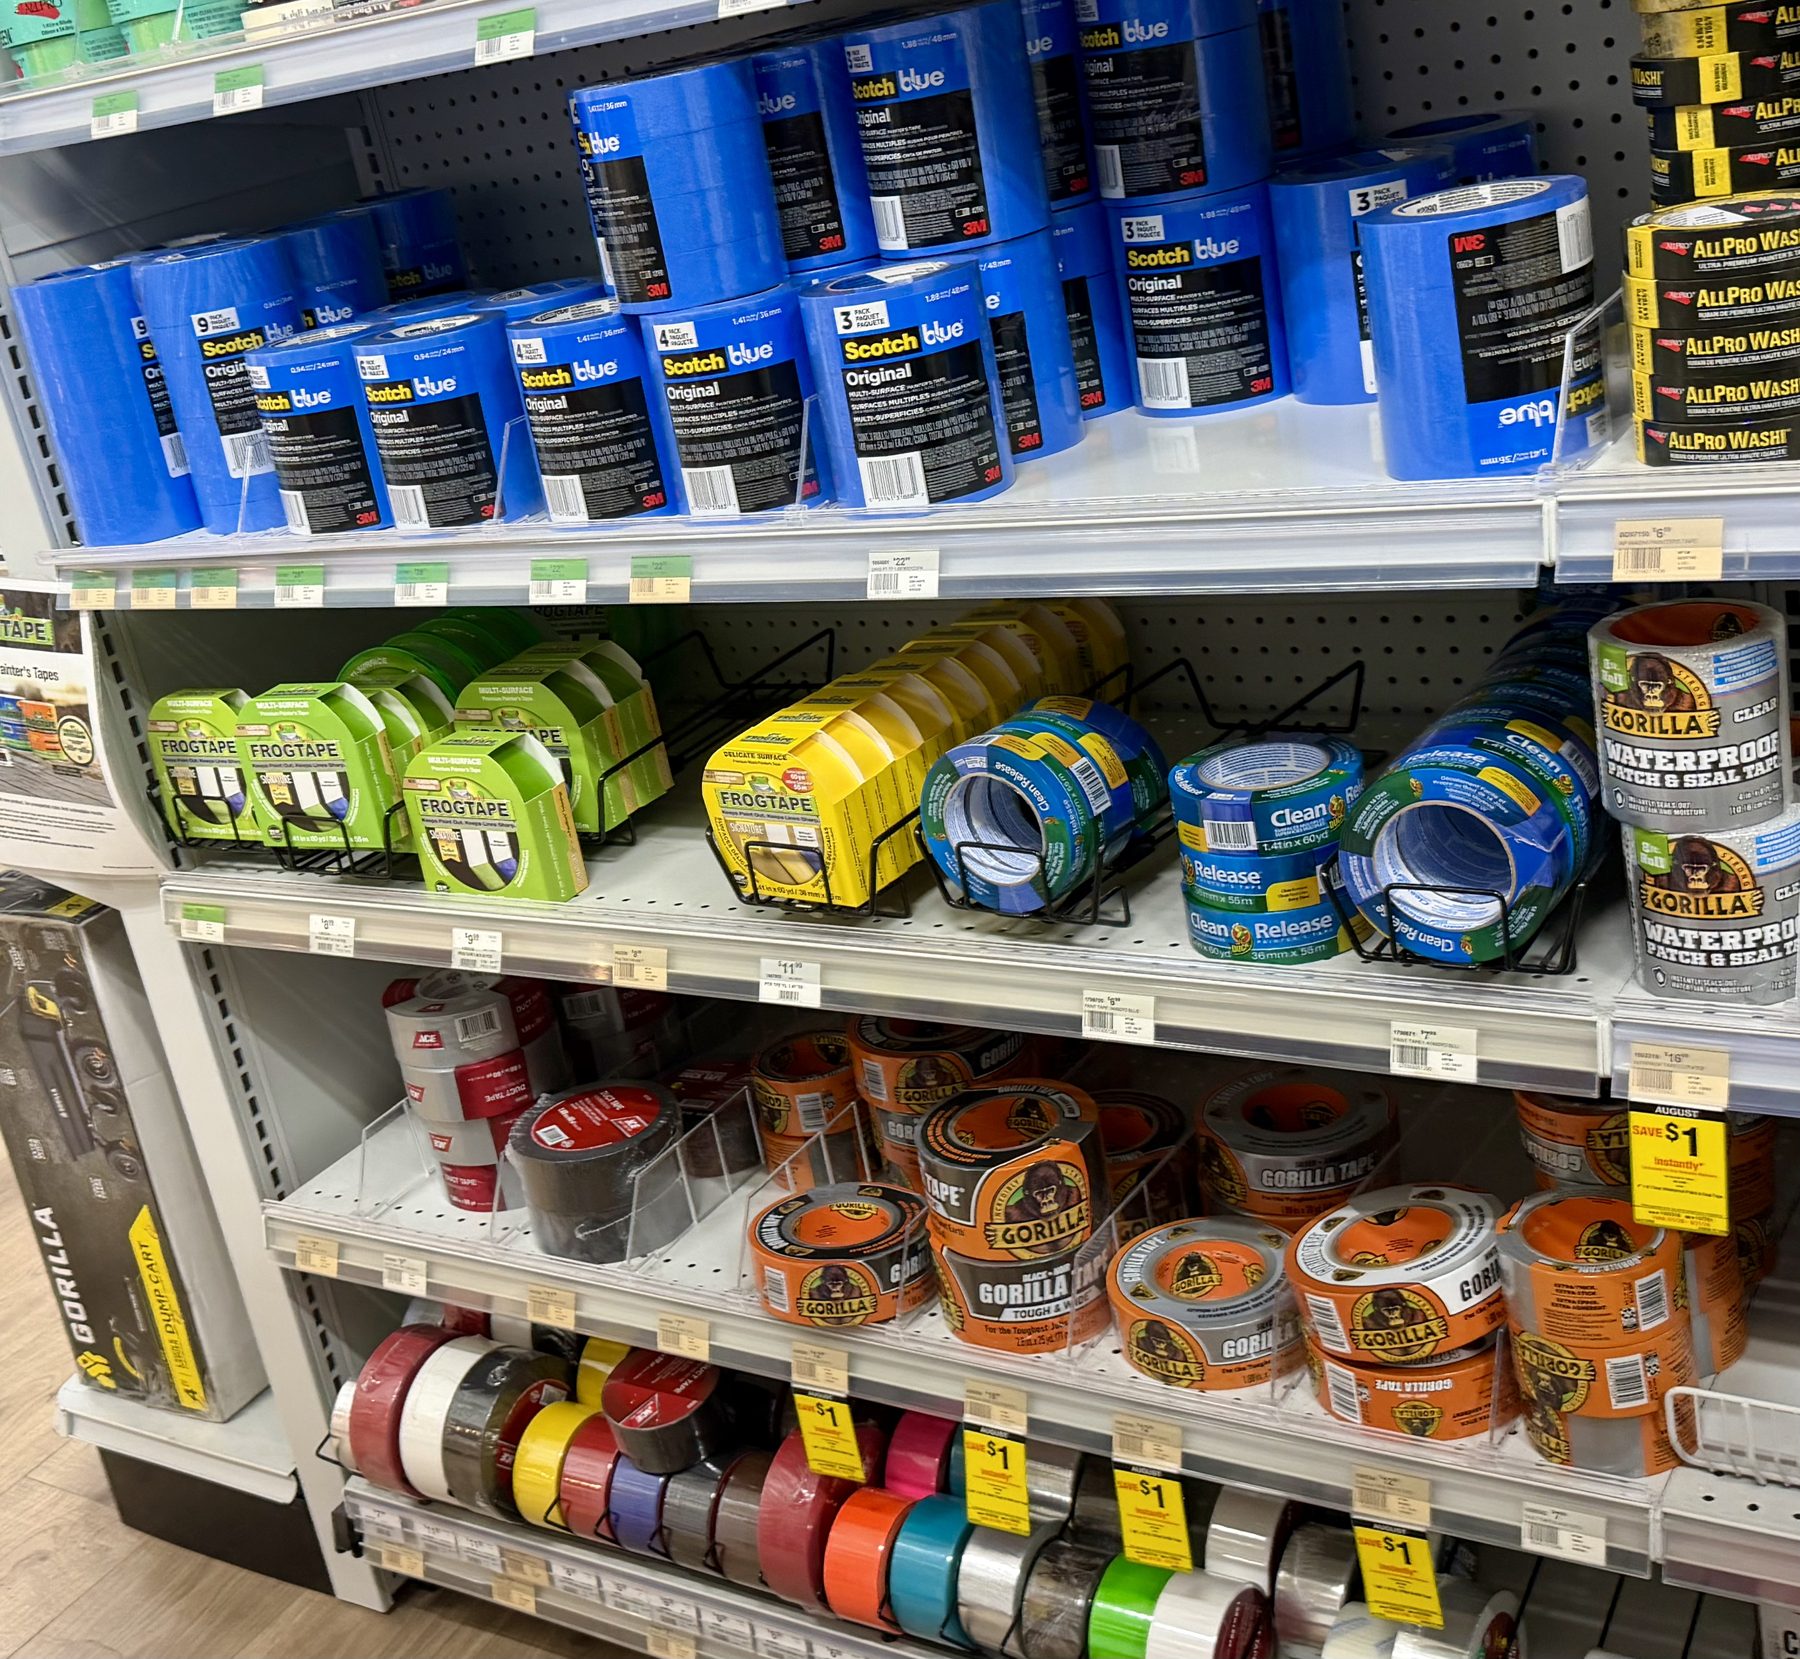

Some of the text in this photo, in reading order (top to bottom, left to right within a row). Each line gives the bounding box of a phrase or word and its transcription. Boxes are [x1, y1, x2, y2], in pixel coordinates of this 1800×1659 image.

[1122, 19, 1168, 42] blue
[898, 68, 945, 91] blue
[1180, 169, 1204, 185] 3M
[1374, 187, 1391, 195] PACK
[1356, 192, 1370, 211] 3
[963, 219, 987, 236] 3M
[1124, 222, 1135, 239] 3
[819, 235, 842, 249] 3M
[1454, 234, 1486, 253] 3M
[1127, 237, 1239, 267] Scotch blue
[1698, 258, 1757, 270] ULTRA PREMIUM
[646, 283, 668, 297] 3M
[1128, 275, 1182, 293] Original
[315, 305, 352, 324] blue
[854, 308, 871, 316] PACK
[856, 313, 880, 321] PAQUET
[1160, 304, 1198, 313] MULTIPLES
[197, 317, 209, 333] 9
[840, 310, 853, 330] 3
[856, 318, 885, 327] PAQUETE
[202, 322, 293, 356] Scotch blue
[658, 329, 669, 347] 4
[845, 321, 964, 360] Scotch blue
[1749, 328, 1800, 351] WASH
[516, 344, 523, 360] 4
[663, 342, 773, 378] Scotch blue
[522, 359, 618, 389] Scotch blue
[846, 363, 913, 387] Original
[366, 375, 456, 403] Scotch blue
[667, 382, 720, 402] Original
[848, 385, 906, 398] MULTI-SURFACE
[1250, 378, 1270, 392] 3M
[291, 389, 331, 407] blue
[525, 396, 568, 414] Original
[851, 393, 931, 410] SURFACES MULTIPLES
[1081, 392, 1102, 406] 3M
[370, 410, 409, 426] Original
[854, 408, 925, 423] MULTI-SUPERFICIES
[1498, 399, 1556, 428] blue
[1018, 433, 1040, 449] 3M
[1728, 430, 1787, 448] WASHI
[984, 465, 1001, 483] 3M
[642, 492, 664, 508] 3M
[356, 511, 376, 524] 3M
[0, 663, 59, 682] ainter's Tapes
[1676, 670, 1706, 707] STRONG
[1734, 697, 1777, 723] CLEAR
[1611, 710, 1704, 734] GORILLA
[161, 740, 236, 754] FROGTAPE
[249, 743, 339, 759] FROGTAPE
[723, 751, 788, 761] DELICATE SURFACE
[1505, 733, 1562, 774] Clean
[1605, 731, 1779, 771] WATERPROOF
[1608, 761, 1741, 788] PATCH & SEAL
[995, 761, 1049, 812] Clean Release
[420, 799, 509, 816] FROGTAPE
[720, 792, 812, 811] FROGTAPE
[1271, 802, 1327, 826] Clean
[1303, 832, 1329, 845] 60yd
[1194, 862, 1261, 884] Release
[1721, 852, 1750, 887] STRONG
[1651, 892, 1748, 915] GORILLA
[1191, 912, 1229, 937] Clean
[1254, 916, 1332, 939] Release
[1417, 932, 1455, 952] Clean
[1251, 947, 1287, 960] 36mm
[1647, 941, 1783, 967] PATCH & SEAL
[417, 1034, 437, 1043] ACE
[485, 1084, 526, 1103] DUCT TAPE
[903, 1087, 959, 1103] GORILLA
[1654, 1106, 1699, 1118] AUGUST
[1632, 1121, 1698, 1157] SAVE $1
[1261, 1154, 1376, 1189] GORILLA TAPE
[925, 1173, 962, 1206] TAPE
[995, 1179, 1020, 1222] INCREDIBLY
[1002, 1206, 1085, 1245] GORILLA
[1122, 1235, 1166, 1285] GORILLA TAPE
[33, 1204, 96, 1346] GORILLA
[1022, 1271, 1048, 1282] BLACK
[1174, 1276, 1214, 1292] GORILLA
[137, 1242, 176, 1335] DUMP CART
[979, 1274, 1068, 1305] GORILLA
[805, 1300, 868, 1316] GORILLA
[1012, 1306, 1050, 1319] TOUGH
[985, 1325, 1048, 1335] For the Toughest
[1363, 1324, 1437, 1346] GORILLA
[1135, 1354, 1192, 1377] GORILLA
[1524, 1351, 1582, 1376] GORILLA
[1375, 1379, 1452, 1392] GORILLA TAPE
[816, 1402, 838, 1427] $1
[987, 1440, 1009, 1470] $1
[1139, 1480, 1165, 1508] $1
[1383, 1537, 1412, 1565] $1
